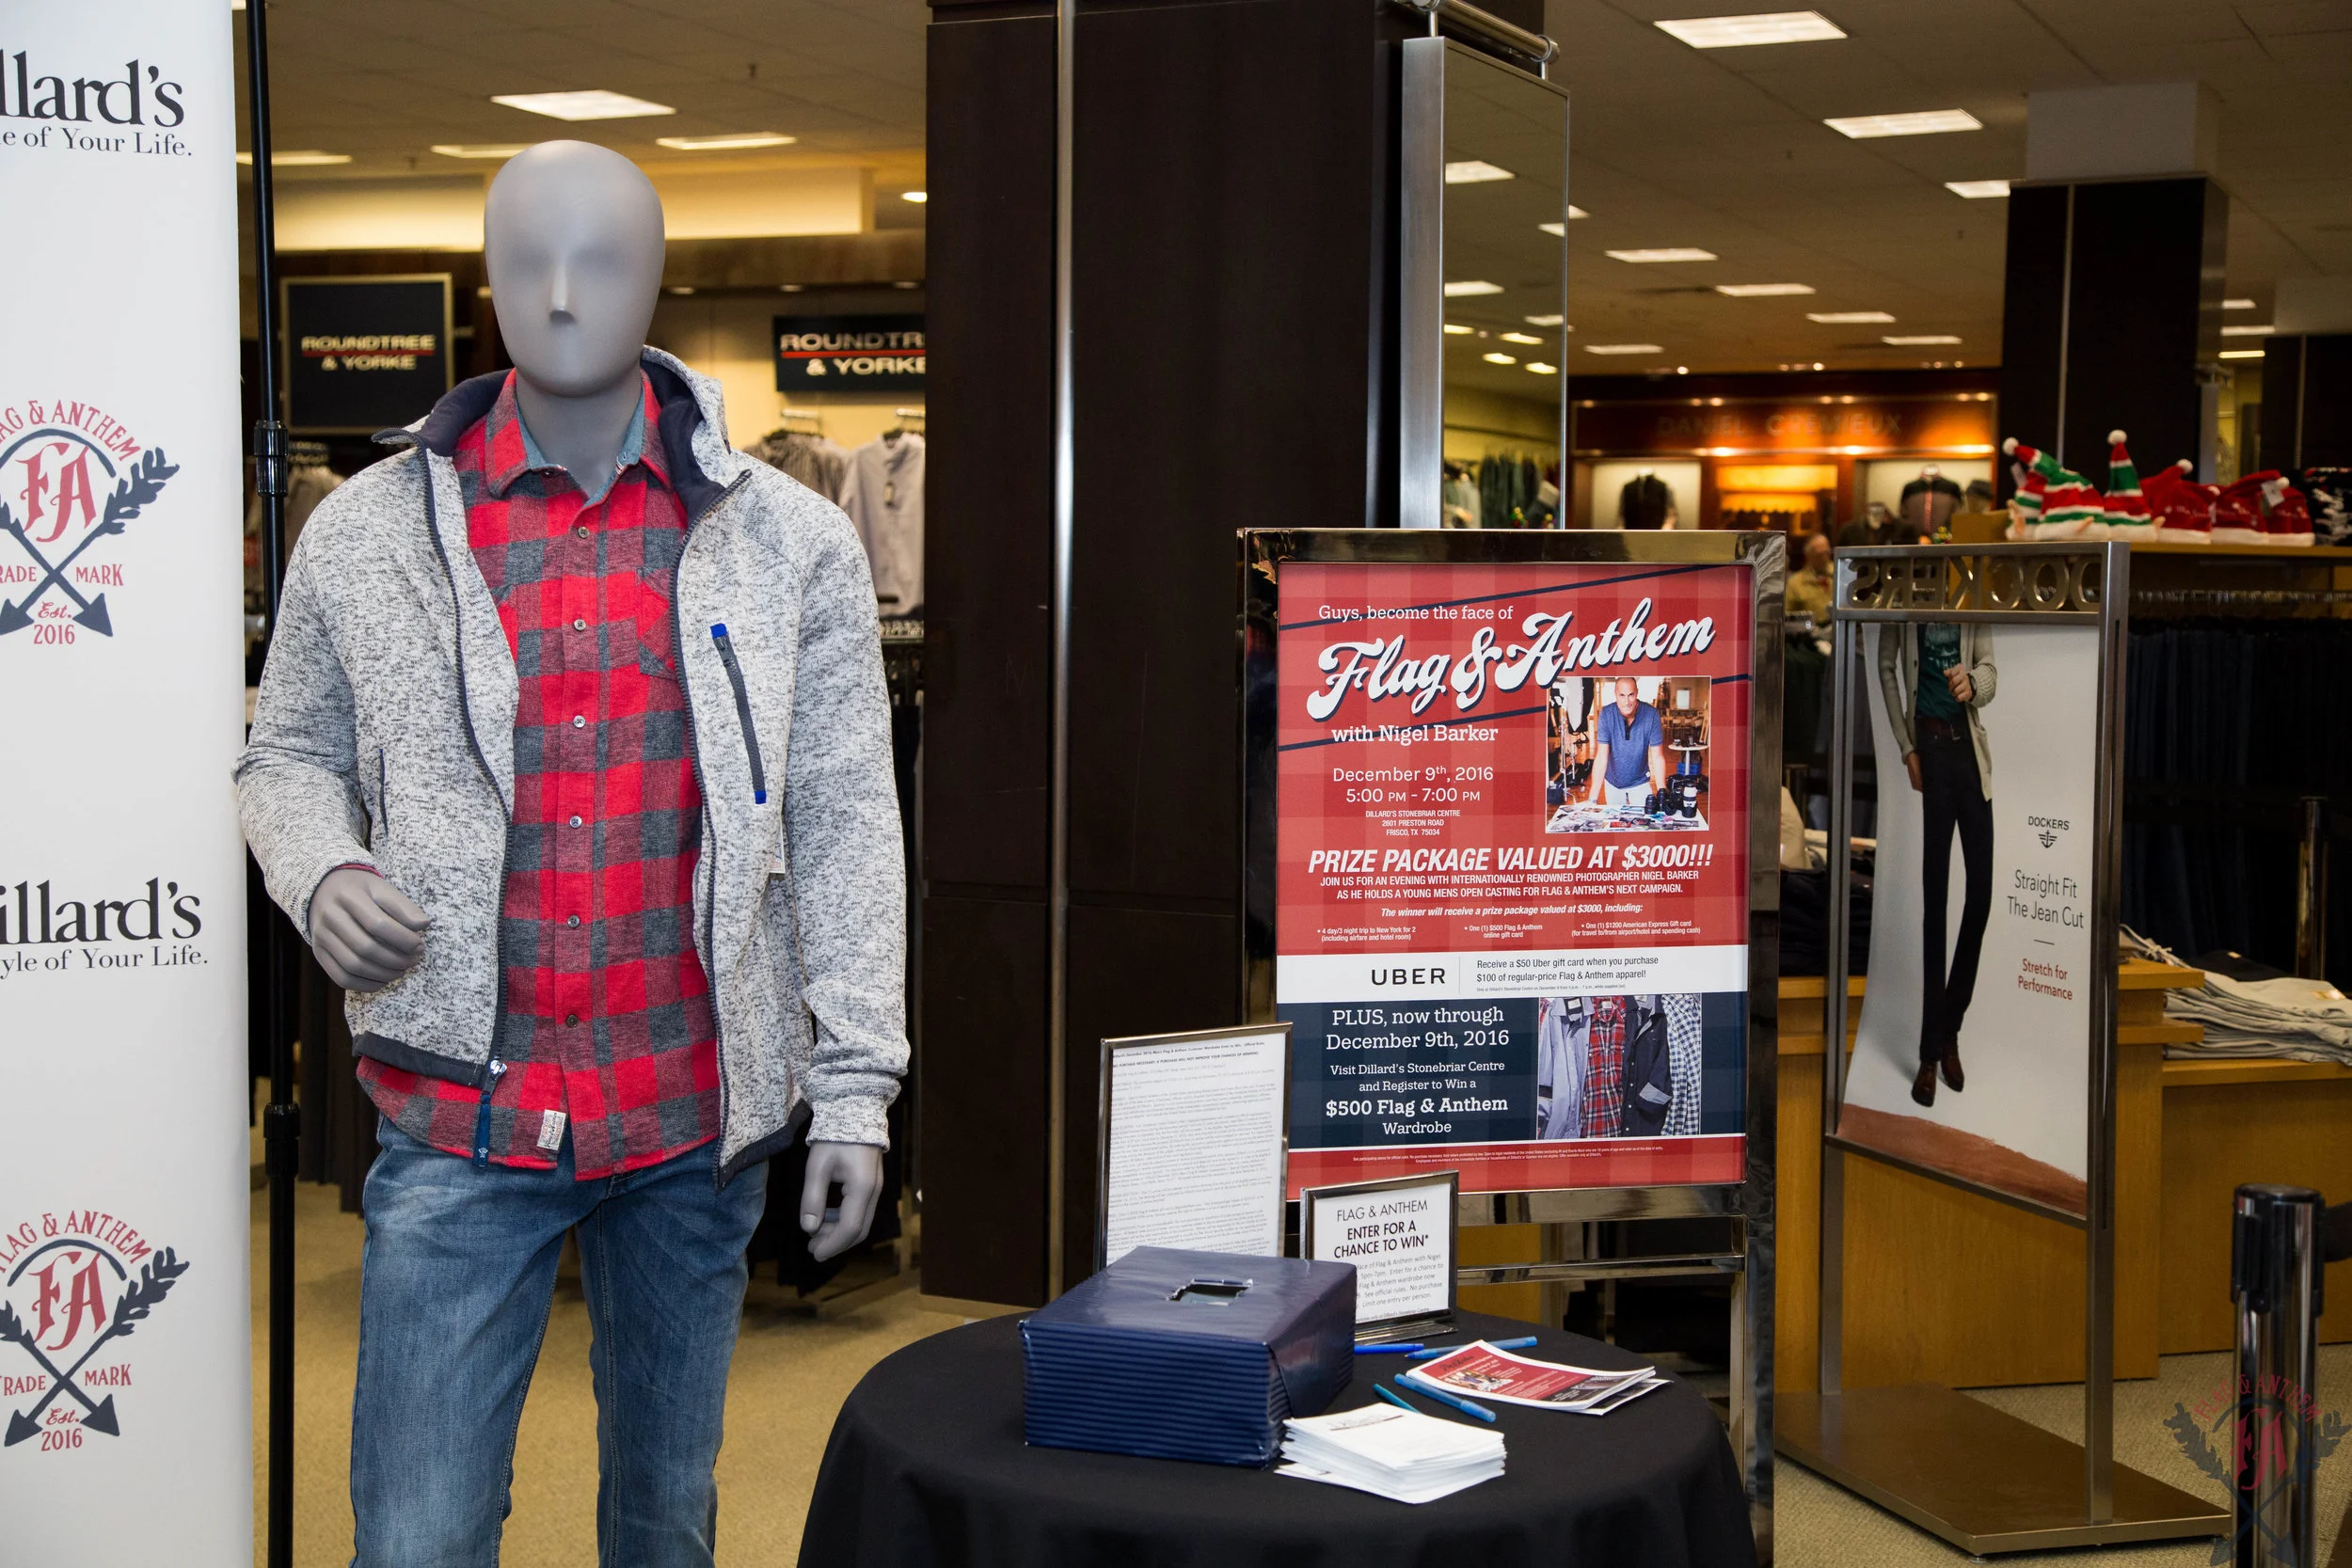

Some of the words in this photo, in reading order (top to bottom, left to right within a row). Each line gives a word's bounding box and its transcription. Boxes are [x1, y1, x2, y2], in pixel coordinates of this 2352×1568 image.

[24, 126, 52, 148] of
[60, 127, 125, 152] Your
[134, 132, 192, 156] Life.
[301, 335, 436, 352] ROUNDTREE
[321, 356, 338, 371] &
[342, 355, 417, 371] YORKE
[806, 358, 826, 376] &
[833, 356, 926, 375] YORKE
[28, 400, 46, 425] &
[51, 400, 141, 462] ANTHEM
[76, 563, 124, 586] MARK
[38, 602, 72, 619] Est.
[1319, 605, 1362, 623] Guys,
[1367, 605, 1429, 620] become
[1433, 605, 1457, 620] the
[1461, 605, 1494, 620] face
[1498, 605, 1513, 620] of
[34, 624, 75, 645] 2016
[1307, 634, 1452, 721] Flag
[1451, 626, 1502, 712] &
[1494, 596, 1716, 691] Anthem
[1331, 725, 1374, 743] with
[1378, 725, 1428, 746] Nigel
[1433, 725, 1498, 742] Barker
[1333, 767, 1421, 782] December
[1425, 766, 1451, 783] 9th,
[1454, 767, 1494, 782] 2016
[1346, 788, 1383, 802] 5:00
[1389, 792, 1406, 802] PM
[1422, 788, 1457, 802] 7:00
[1463, 791, 1481, 801] PM
[1386, 829, 1409, 837] FRISCO,
[1421, 828, 1440, 836] 75034
[2028, 816, 2070, 831] DOCKERS
[1308, 849, 1377, 874] PRIZE
[1382, 847, 1491, 872] PACKAGE
[1497, 847, 1583, 870] VALUED
[1588, 846, 1619, 869] AT
[1622, 844, 1713, 870] $3000!!!
[1320, 877, 1340, 887] JOIN
[1343, 876, 1355, 886] US
[1356, 876, 1374, 885] FOR
[1375, 876, 1388, 885] AN
[1390, 876, 1426, 885] EVENING
[1427, 875, 1449, 884] WITH
[1451, 874, 1524, 884] INTERNATIONALLY
[1527, 872, 1573, 882] RENOWNED
[1575, 872, 1639, 882] PHOTOGRAPHER
[1641, 871, 1665, 880] NIGEL
[1667, 871, 1699, 880] BARKER
[2014, 869, 2059, 899] Straight
[2062, 878, 2077, 898] Fit
[1337, 890, 1349, 899] AS
[1350, 890, 1362, 899] HE
[1364, 889, 1393, 898] HOLDS
[1394, 889, 1401, 898] A
[1403, 889, 1432, 898] YOUNG
[1433, 888, 1458, 897] MENS
[1460, 888, 1483, 897] OPEN
[1485, 887, 1521, 896] CASTING
[1523, 886, 1540, 896] FOR
[1541, 886, 1563, 895] FLAG
[1565, 886, 1571, 895] &
[1572, 885, 1614, 895] ANTHEM'S
[1616, 884, 1637, 894] NEXT
[1639, 884, 1683, 894] CAMPAIGN.
[2007, 895, 2028, 918] The
[2031, 901, 2058, 924] Jean
[2062, 906, 2084, 929] Cut
[44, 949, 72, 971] of
[79, 947, 144, 969] Your
[151, 943, 208, 967] Life.
[1477, 959, 1507, 969] Receive
[1516, 958, 1531, 968] $50
[1533, 958, 1550, 967] Uber
[1552, 958, 1565, 969] gift
[1566, 958, 1584, 967] card
[1586, 958, 1607, 966] when
[1608, 958, 1623, 967] you
[1624, 957, 1659, 966] purchase
[1371, 968, 1445, 986] UBER
[1476, 974, 1497, 983] $100
[1498, 973, 1506, 981] of
[1507, 972, 1557, 983] regular-price
[1559, 972, 1576, 981] Flag
[1577, 972, 1583, 980] &
[1584, 971, 1613, 980] Anthem
[1615, 970, 1646, 980] apparel!
[2022, 958, 2053, 978] Stretch
[2055, 963, 2068, 980] for
[2018, 974, 2073, 1001] Performance
[1332, 1008, 1388, 1027] PLUS,
[1391, 1011, 1431, 1024] now
[1434, 1006, 1504, 1025] through
[1326, 1033, 1421, 1050] December
[1424, 1032, 1458, 1050] 9th,
[1463, 1030, 1509, 1046] 2016
[1330, 1065, 1357, 1075] Visit
[1358, 1063, 1405, 1075] Dillard's
[1406, 1062, 1467, 1073] Stonebriar
[1468, 1061, 1505, 1072] Centre
[1359, 1082, 1380, 1092] and
[1382, 1081, 1429, 1093] Register
[1431, 1081, 1442, 1090] to
[1444, 1079, 1468, 1089] Win
[1326, 1100, 1372, 1117] $500
[1376, 1099, 1415, 1117] Flag
[1421, 1098, 1435, 1113] &
[1438, 1097, 1508, 1113] Anthem
[1382, 1120, 1452, 1135] Wardrobe
[1337, 1207, 1365, 1223] FLAG
[1368, 1205, 1376, 1218] &
[1380, 1199, 1428, 1216] ANTHEM
[41, 1212, 60, 1237] &
[64, 1210, 152, 1264] ANTHEM
[1347, 1224, 1380, 1241] ENTER
[1384, 1222, 1405, 1234] FOR
[1407, 1220, 1417, 1232] A
[1334, 1241, 1379, 1259] CHANCE
[1383, 1238, 1397, 1252] TO
[85, 1363, 132, 1386] MARK
[0, 1375, 46, 1396] RADE
[46, 1408, 80, 1426] Est.
[40, 1428, 83, 1451] 2016
